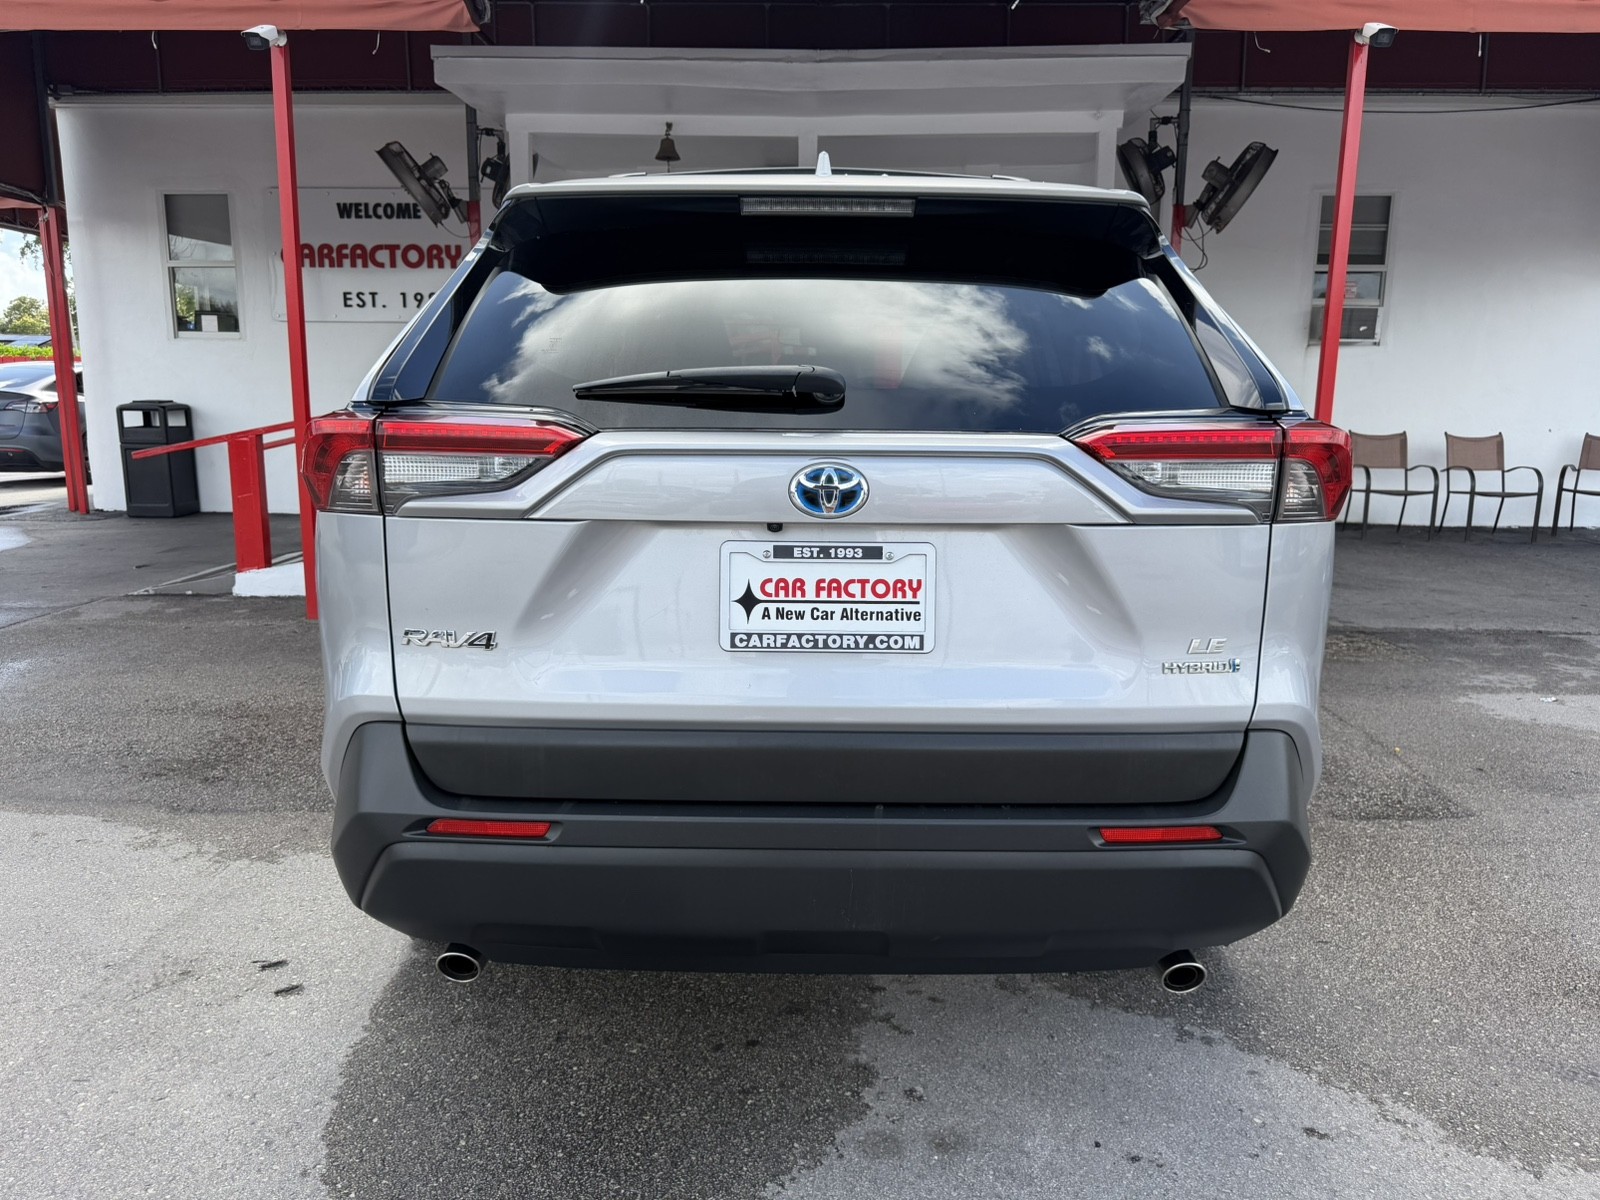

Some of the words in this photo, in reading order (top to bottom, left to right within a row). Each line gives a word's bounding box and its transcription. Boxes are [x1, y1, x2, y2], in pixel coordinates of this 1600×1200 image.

[337, 203, 422, 219] WELCOME
[281, 243, 462, 269] ARFACTORY
[343, 292, 387, 308] EST.
[793, 547, 824, 558] EST.
[829, 547, 863, 558] 1993
[759, 577, 806, 598] CAR
[815, 578, 923, 599] FACTORY
[761, 607, 772, 620] A
[775, 607, 806, 620] New
[810, 607, 836, 621] Car
[840, 607, 922, 622] Alternative
[401, 628, 498, 651] RAV4
[734, 634, 921, 649] CARFACTORY.COM
[1187, 638, 1227, 654] LE
[1162, 661, 1232, 674] HYBRID
